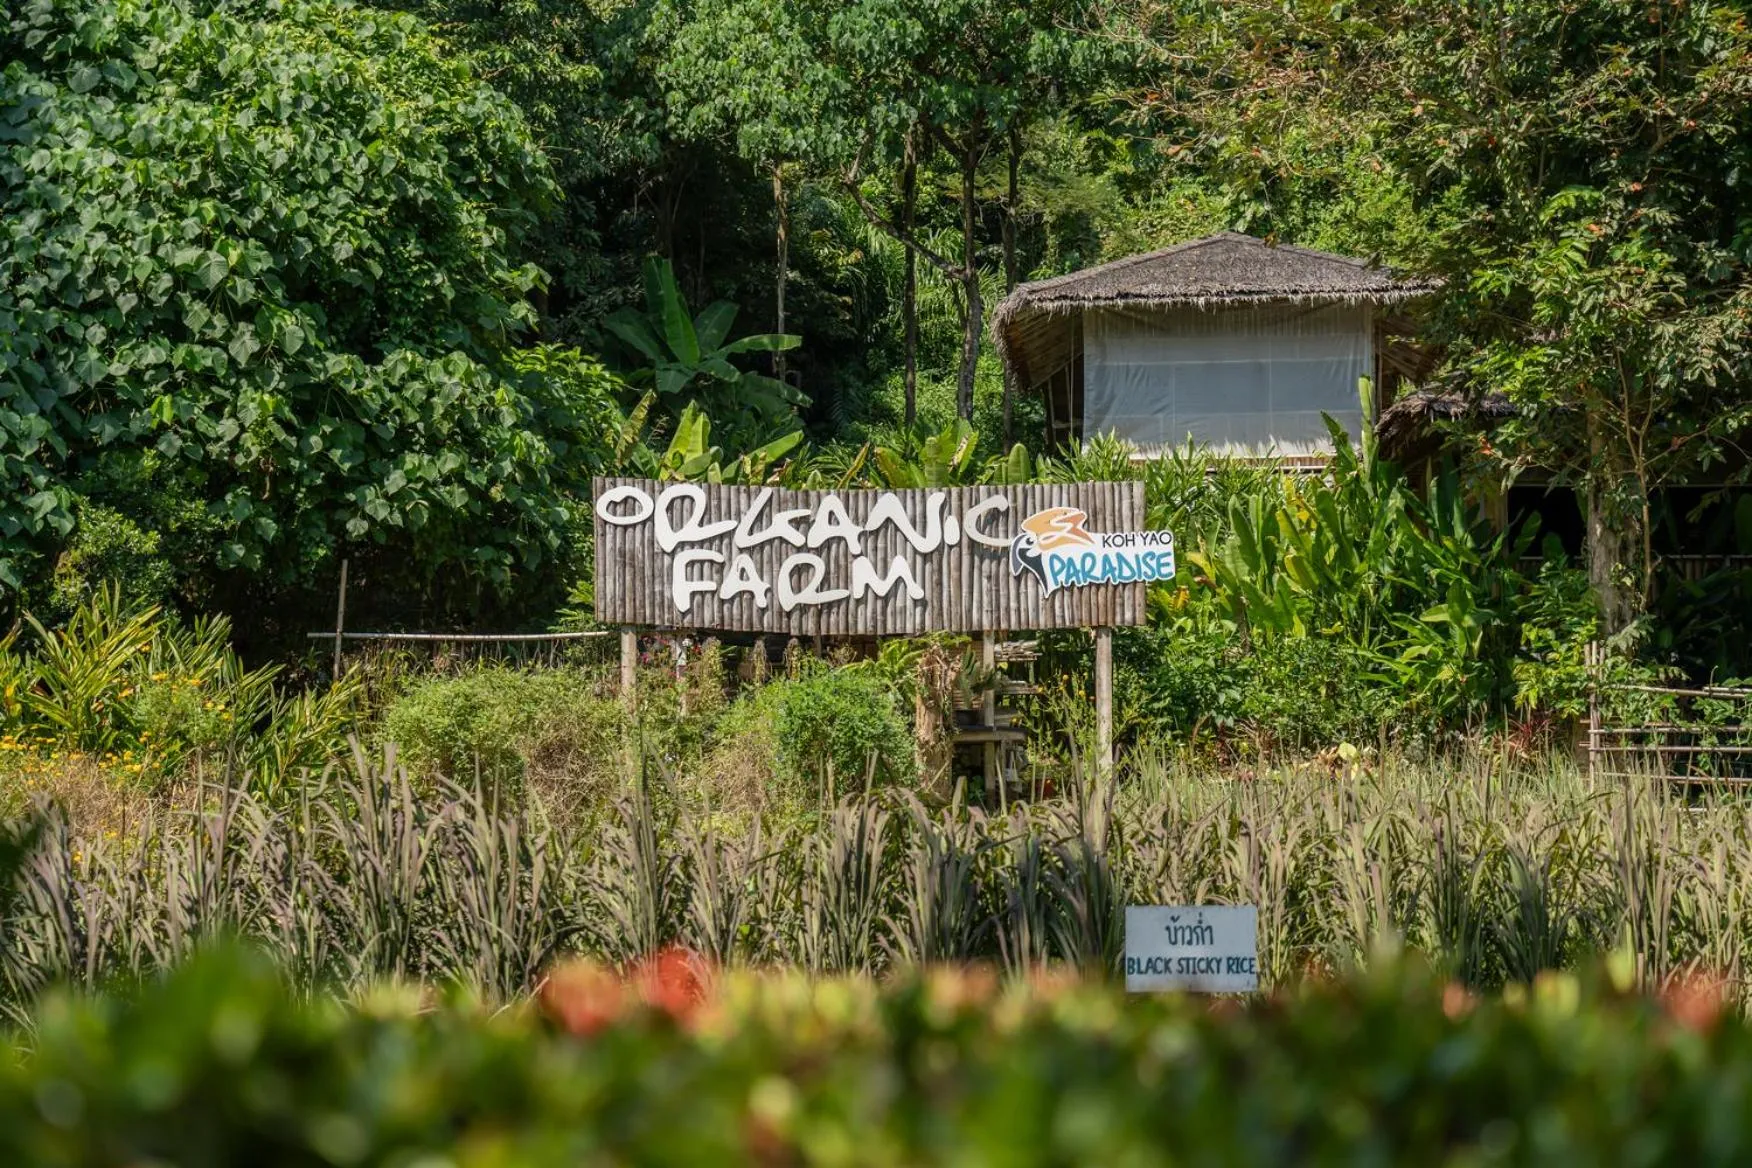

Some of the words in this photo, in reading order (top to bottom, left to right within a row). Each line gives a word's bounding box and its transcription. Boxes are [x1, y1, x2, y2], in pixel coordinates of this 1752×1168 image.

[596, 484, 1013, 554] ORGANIC
[1102, 533, 1136, 549] KOH
[1140, 531, 1173, 546] YAO
[672, 549, 925, 613] FARM
[1049, 551, 1174, 586] PARADISE
[1127, 957, 1172, 975] BLACK
[1176, 957, 1222, 975] STICKY
[1226, 956, 1256, 975] RICE
